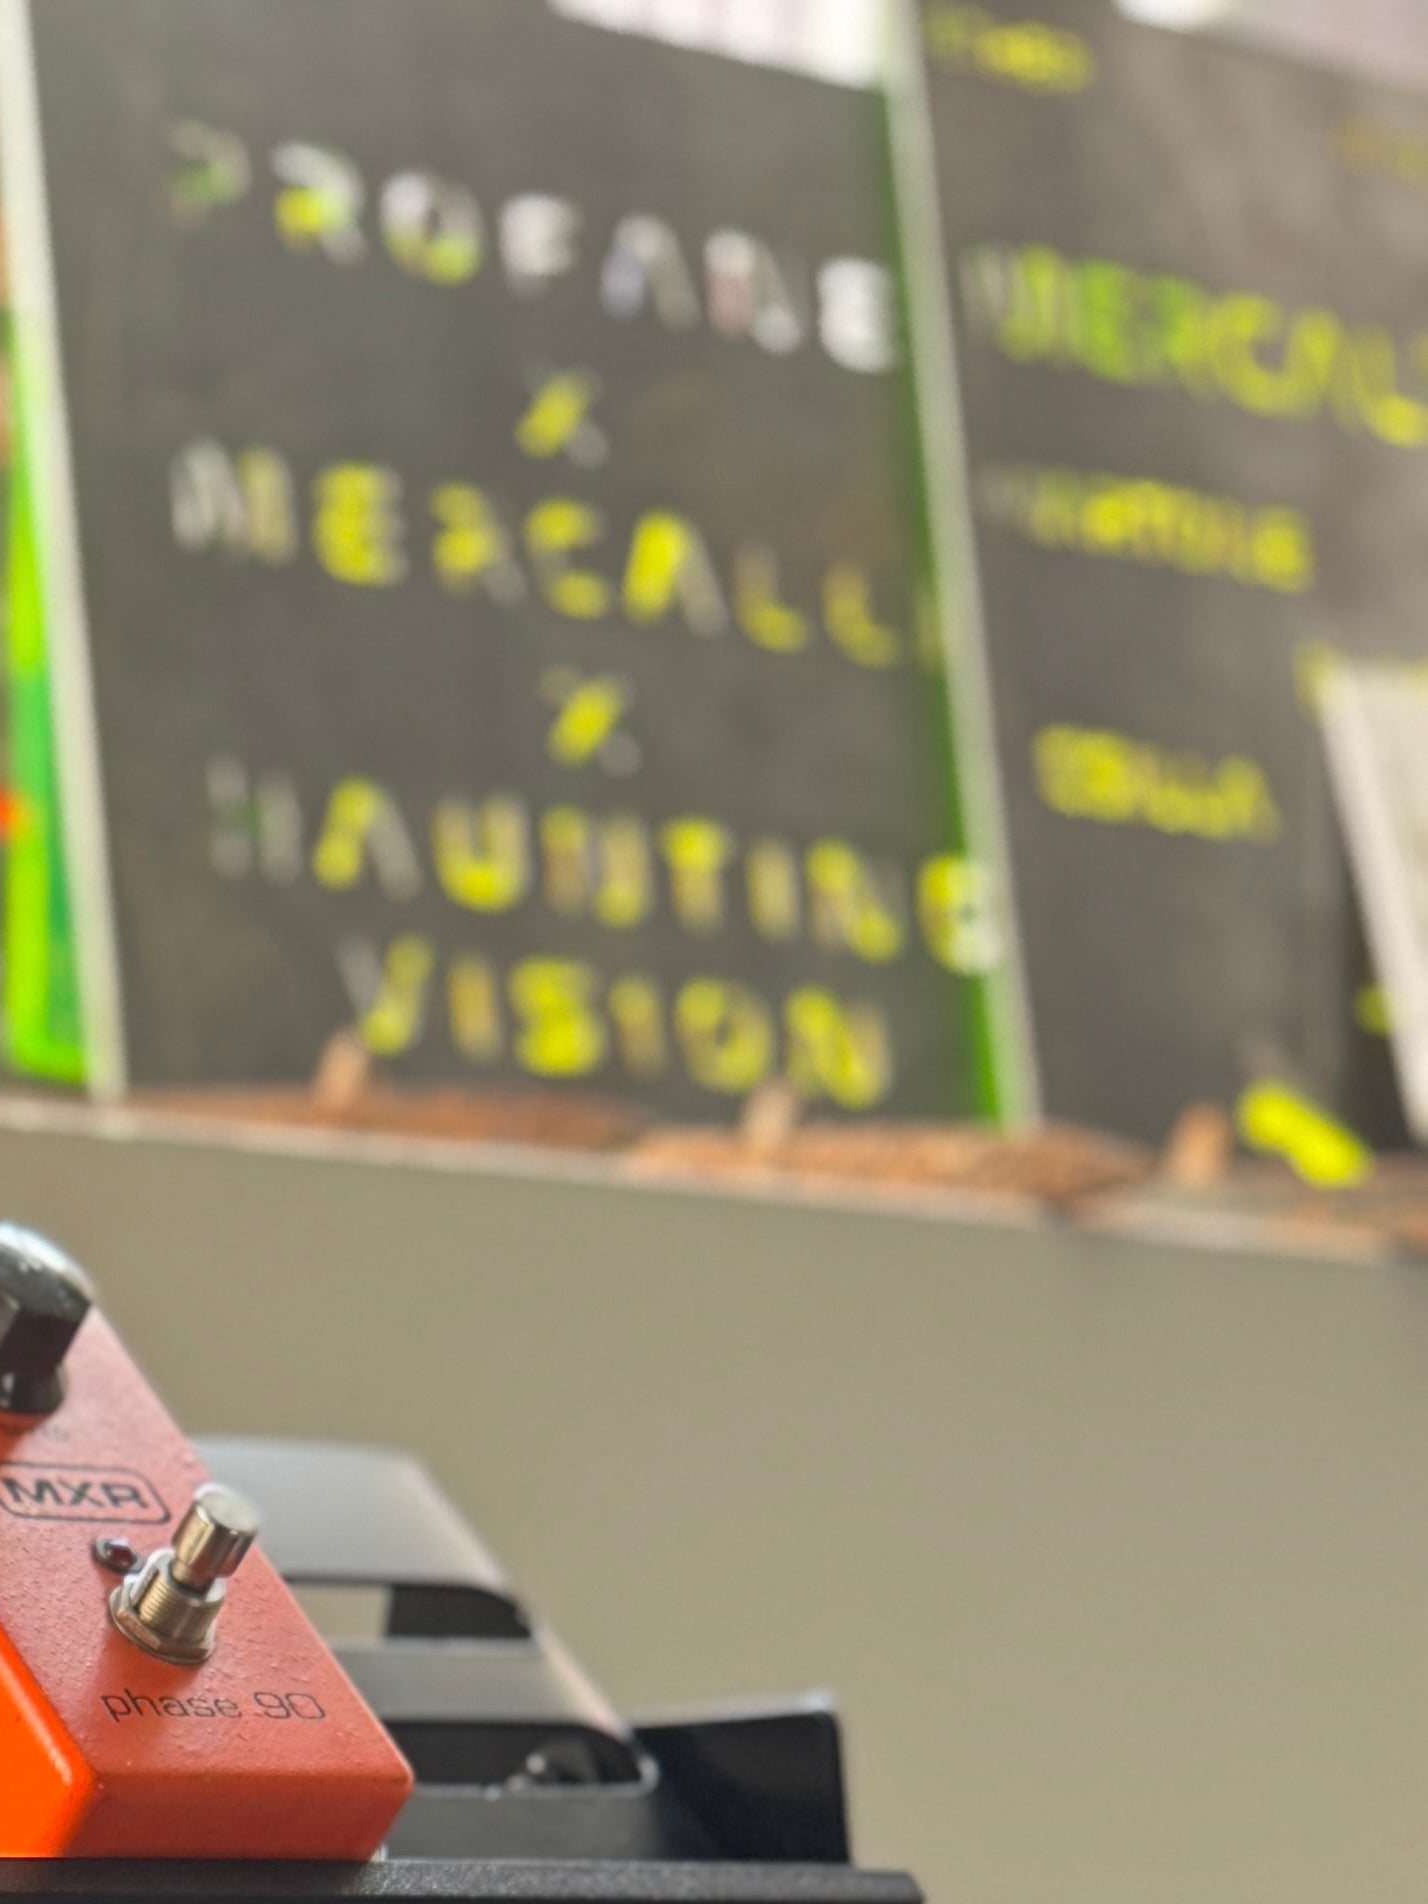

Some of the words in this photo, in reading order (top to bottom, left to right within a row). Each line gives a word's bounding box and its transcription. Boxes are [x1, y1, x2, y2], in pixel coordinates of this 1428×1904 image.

[0, 1476, 154, 1510] MXR
[101, 1688, 242, 1724] phase
[254, 1691, 327, 1721] 90
